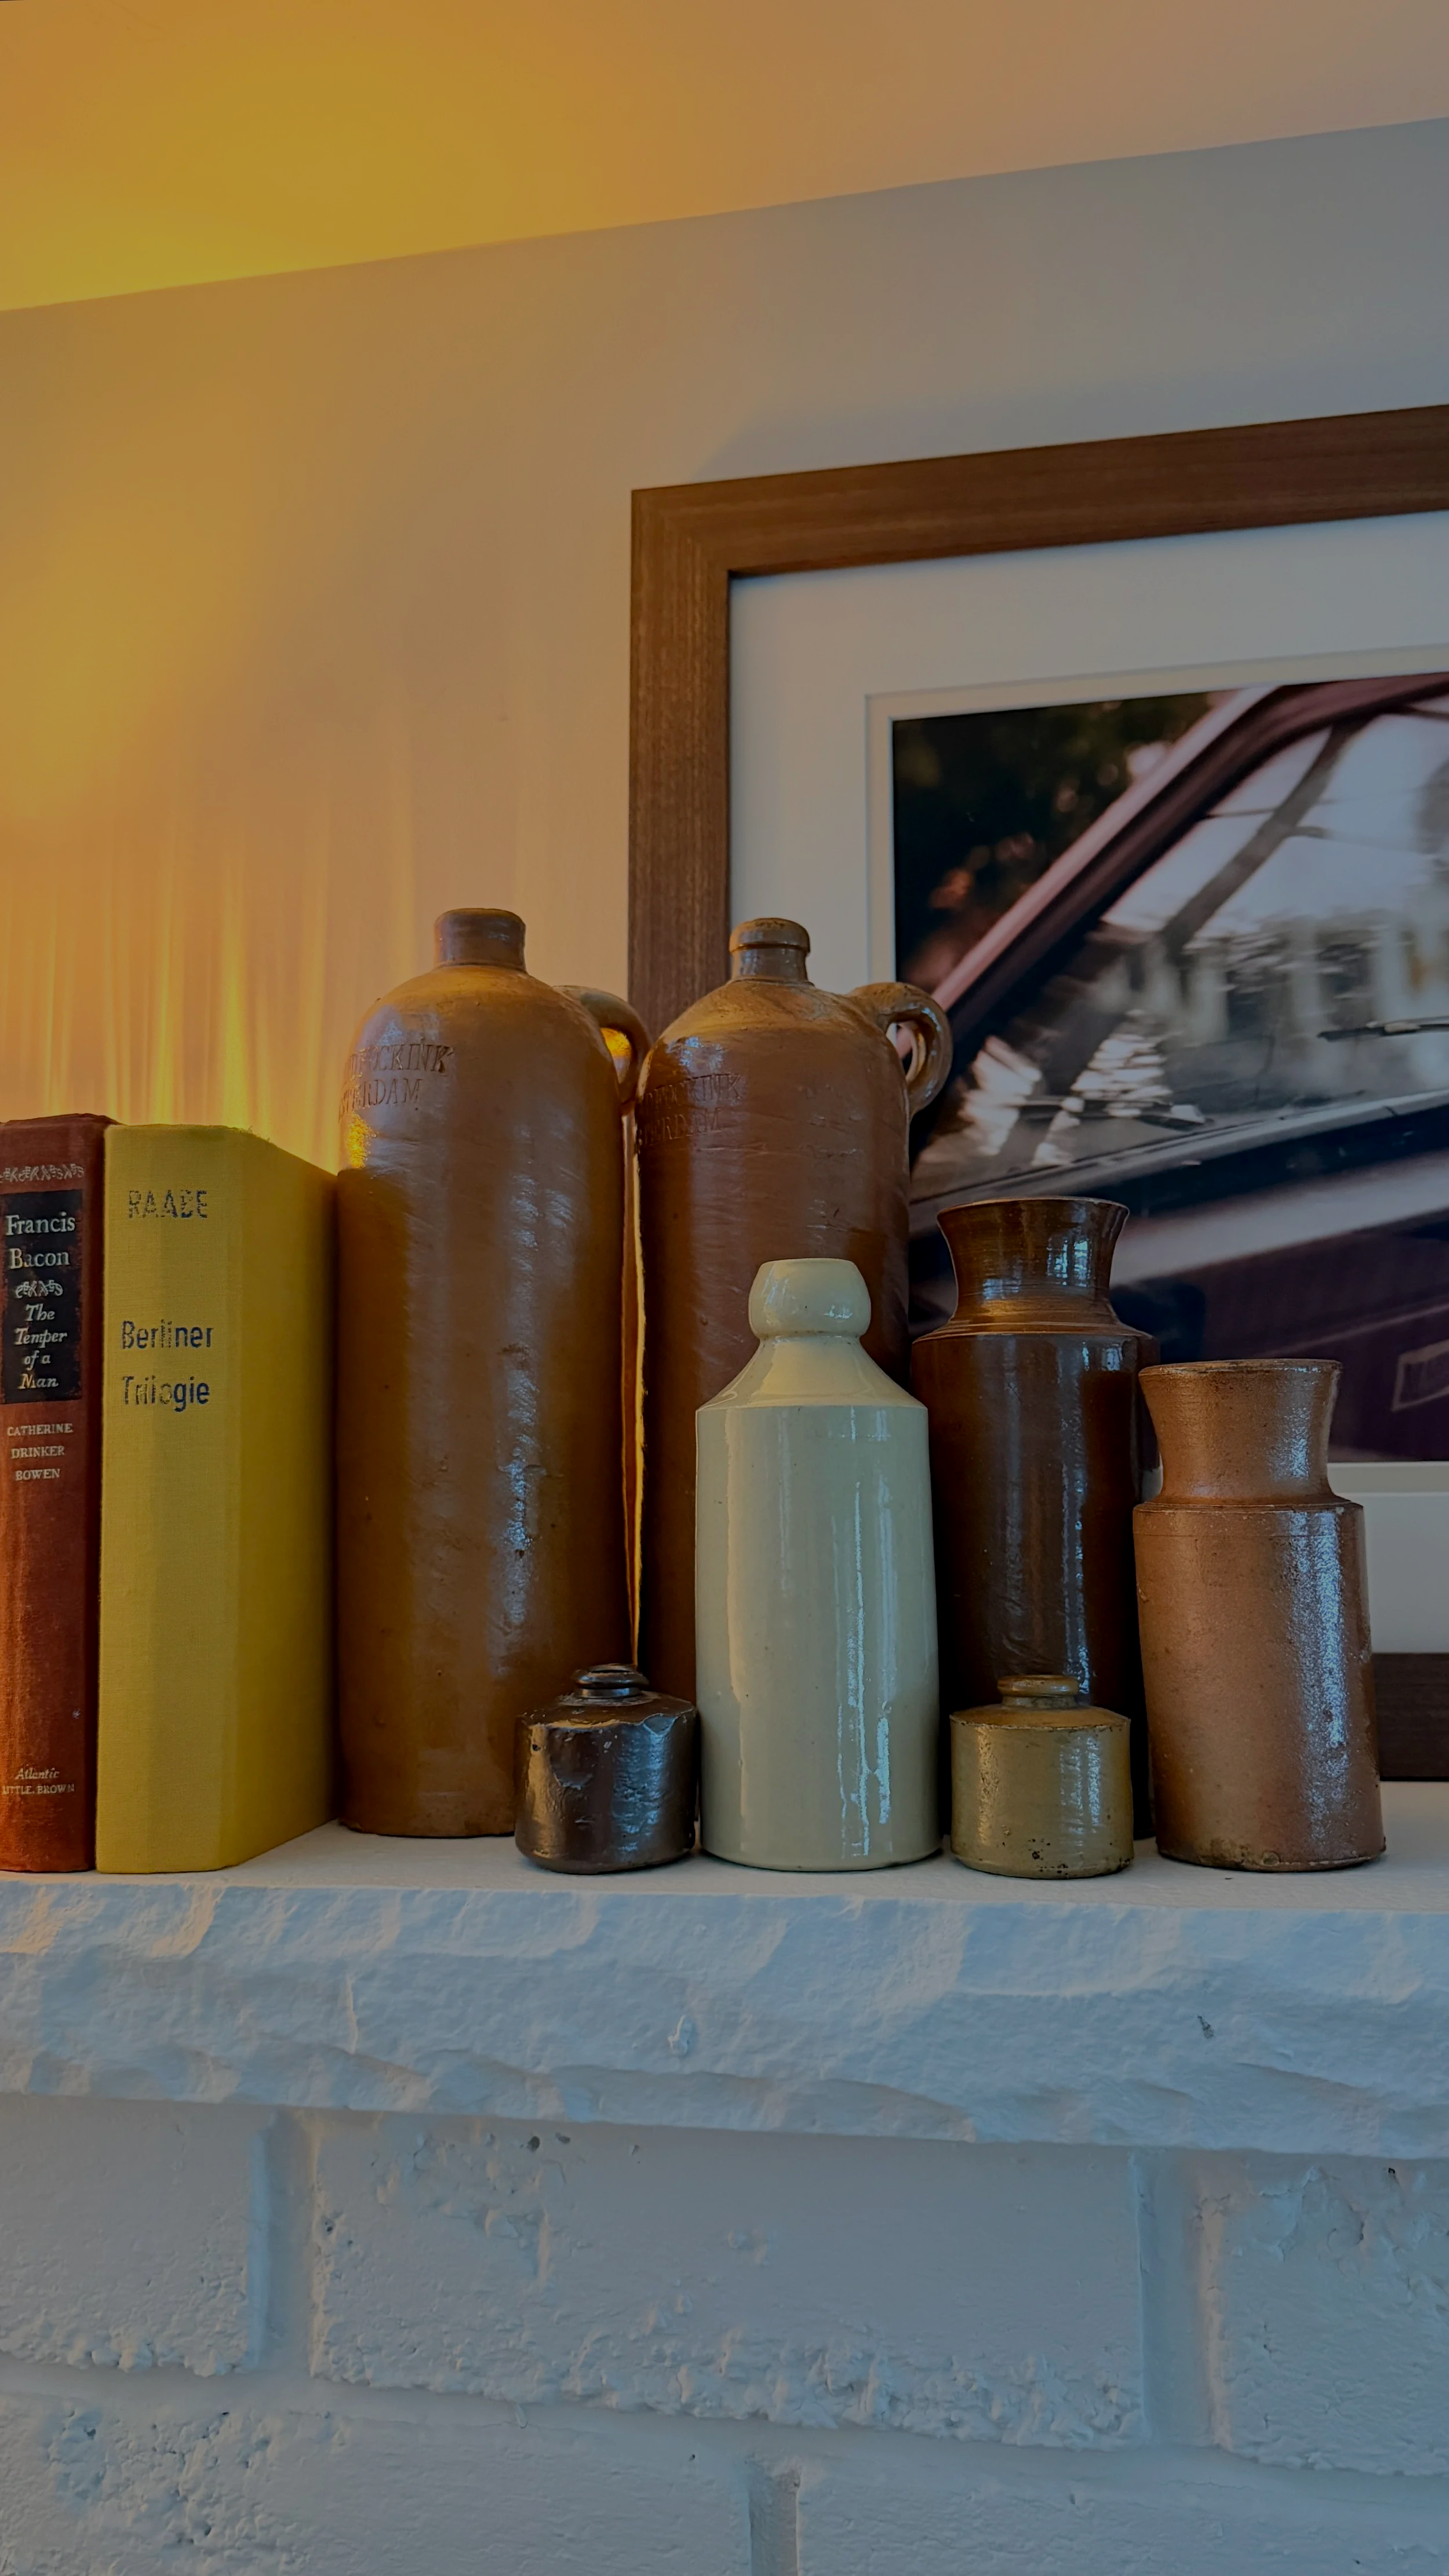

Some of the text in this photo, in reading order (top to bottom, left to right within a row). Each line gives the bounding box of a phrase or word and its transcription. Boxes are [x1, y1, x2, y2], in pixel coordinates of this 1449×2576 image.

[128, 1189, 207, 1218] RAABE
[5, 1212, 75, 1236] Francis
[10, 1248, 70, 1269] Bacon
[26, 1303, 55, 1321] The
[14, 1327, 67, 1349] Temper
[122, 1319, 214, 1349] Berliner
[24, 1350, 51, 1371] of a
[17, 1373, 59, 1389] Man
[122, 1375, 210, 1412] Trilogie
[7, 1423, 74, 1436] CATHERINE
[11, 1445, 65, 1459] DRINKER
[15, 1469, 60, 1481] BOWEN
[14, 1767, 60, 1780] Atlantic
[37, 1784, 75, 1794] BROWN
